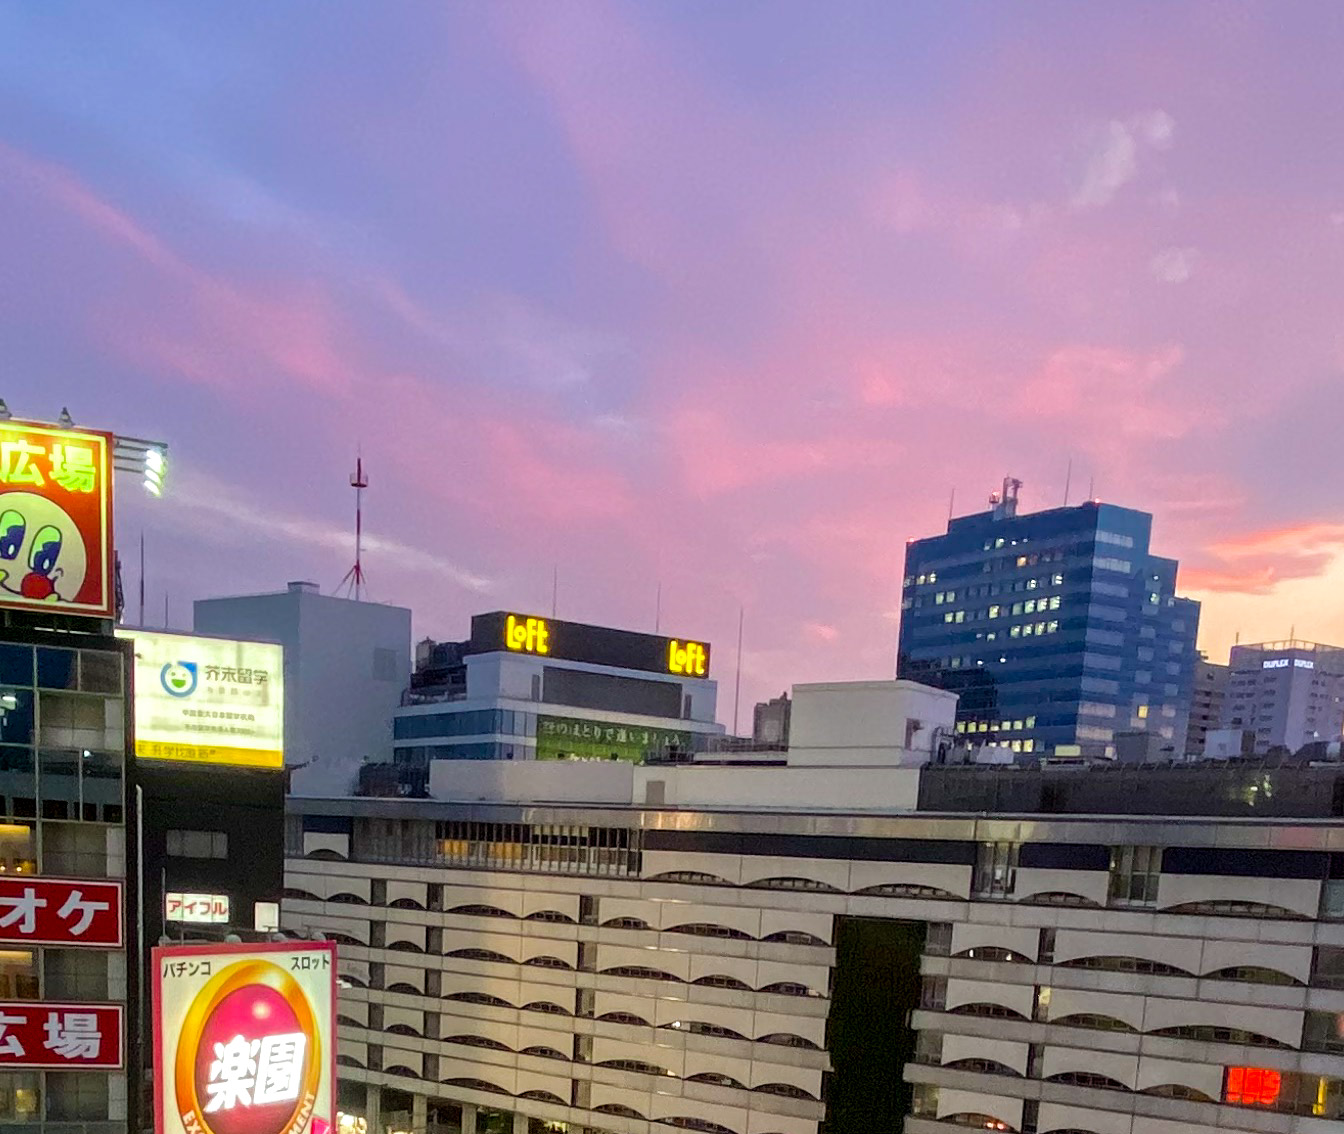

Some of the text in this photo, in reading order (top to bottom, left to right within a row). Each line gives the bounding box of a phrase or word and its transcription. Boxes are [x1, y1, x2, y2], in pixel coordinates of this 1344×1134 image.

[167, 900, 227, 916] アイフル
[163, 961, 211, 979] パチンコ
[291, 954, 330, 971] スロット
[203, 1033, 307, 1113] 楽園
